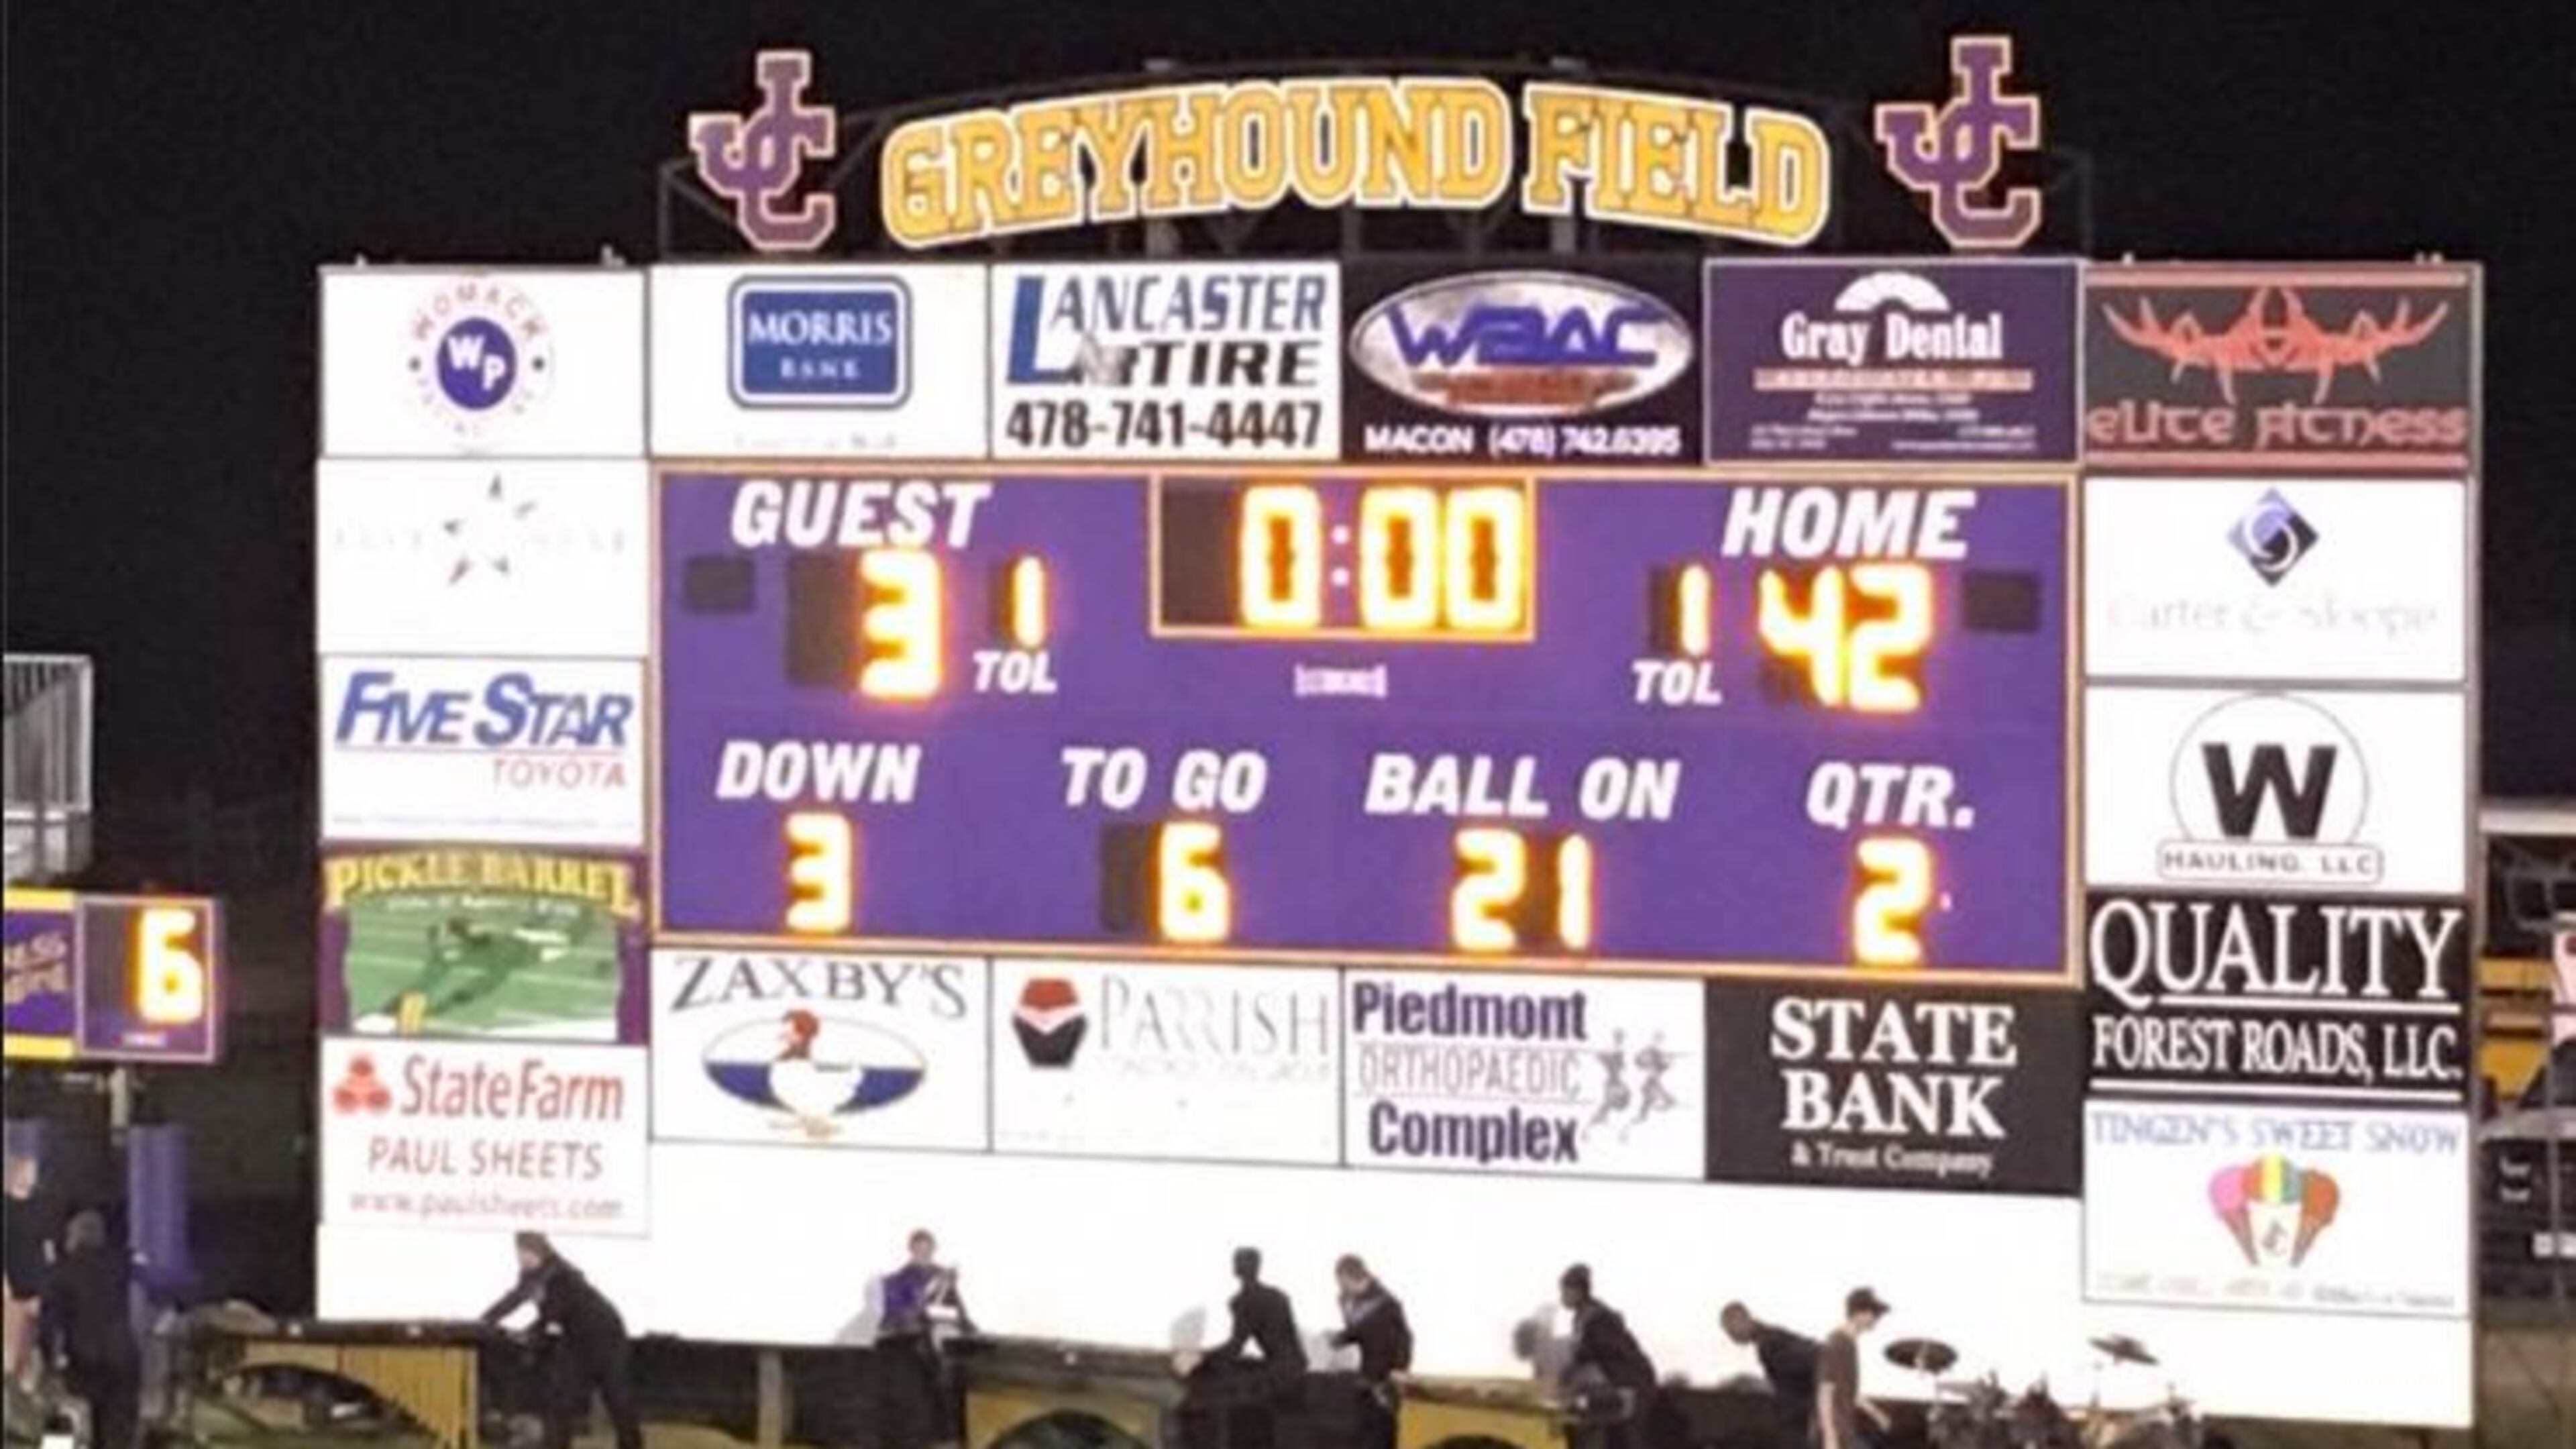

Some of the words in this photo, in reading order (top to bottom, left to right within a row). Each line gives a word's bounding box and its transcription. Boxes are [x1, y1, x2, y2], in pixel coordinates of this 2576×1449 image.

[881, 76, 1512, 250] GREYHOUND
[1523, 80, 1830, 246] FIELD
[748, 310, 893, 345] MORRIS
[1008, 274, 1328, 385] LANCASTER
[1782, 311, 1870, 366] Gray
[1886, 311, 2003, 360] Dental
[781, 358, 860, 378] BANK
[1142, 340, 1323, 387] TIRE
[1006, 398, 1323, 448] 478-741-4447
[1364, 427, 1474, 453] MACON
[731, 480, 994, 550] GUEST
[1721, 487, 1978, 559] HOME
[1241, 484, 1524, 630] 0:00
[860, 549, 943, 697] 3
[1014, 555, 1045, 648] 1
[1680, 565, 1711, 657] 1
[1758, 562, 1932, 712] 42
[973, 649, 1058, 694] TOL
[1631, 659, 1723, 706] TOL
[336, 669, 472, 744] FIVE
[473, 672, 635, 747] STAR
[493, 758, 627, 789] TOYOTA
[716, 741, 921, 803] DOWN
[1061, 748, 1147, 808] TO
[1173, 750, 1268, 812] GO
[1364, 753, 1550, 818] BALL
[1578, 757, 1681, 820] ON
[1806, 761, 1976, 830] QTR.
[2201, 743, 2339, 843] W
[321, 851, 468, 907] PICKLE
[481, 851, 641, 916] BARREL
[785, 812, 852, 933] 3
[1159, 821, 1230, 941] 6
[1452, 827, 1591, 951] 21
[2321, 854, 2372, 874] LLC
[1853, 837, 1932, 964] 2
[139, 907, 203, 1024] 6
[670, 957, 968, 1020] ZAXBY'S
[2090, 899, 2464, 1010] QUALITY
[1100, 973, 1331, 1057] PARRISH
[1353, 980, 1588, 1040] Piedmont
[1770, 996, 2018, 1067] STATE
[1358, 1043, 1582, 1100] ORTHOPAEDIC
[2092, 1015, 2235, 1071] FOREST
[2240, 1020, 2373, 1085] ROADS,
[1368, 1099, 1579, 1164] Complex
[1780, 1068, 2006, 1140] BANK
[2253, 1118, 2355, 1151] SWEET
[2365, 1122, 2463, 1155] SNOW
[368, 1135, 458, 1175] PAUL
[468, 1140, 604, 1181] SHEETS
[1790, 1140, 1811, 1168] &
[1815, 1142, 1879, 1169] Trust
[1883, 1144, 1994, 1179] Company
[350, 1191, 624, 1222] www.paulsheets.com
